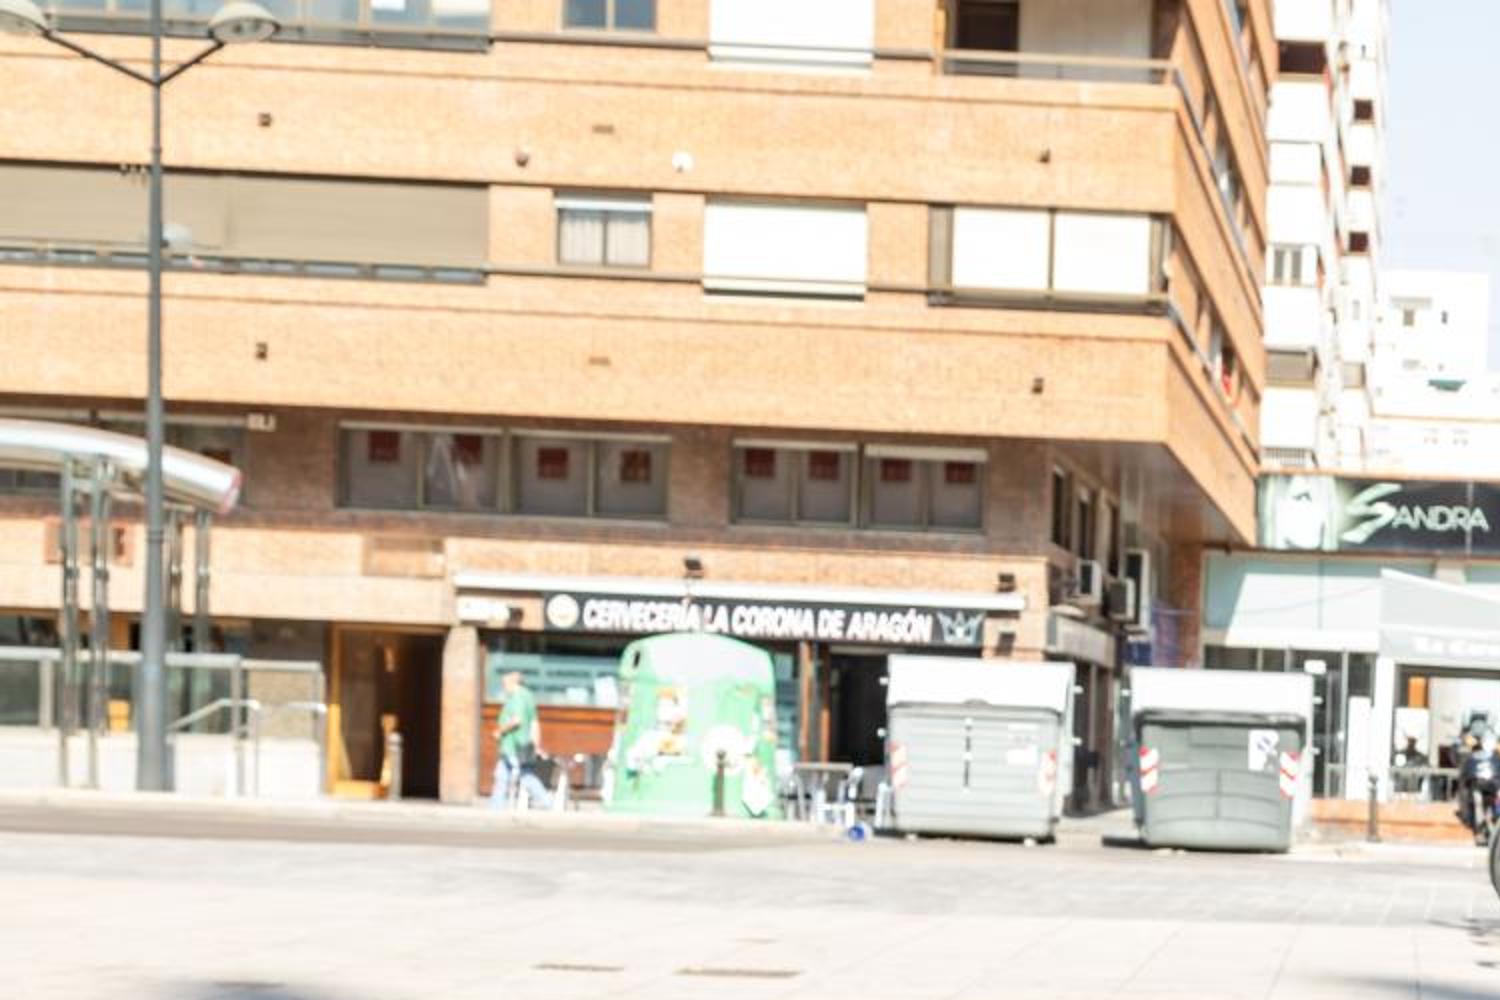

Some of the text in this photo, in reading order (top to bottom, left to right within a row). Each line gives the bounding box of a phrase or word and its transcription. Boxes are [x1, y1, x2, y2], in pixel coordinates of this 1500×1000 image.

[1340, 482, 1490, 544] SANDRA
[582, 597, 933, 643] CERVECERÍA LA CORONA DE ARAGÓN
